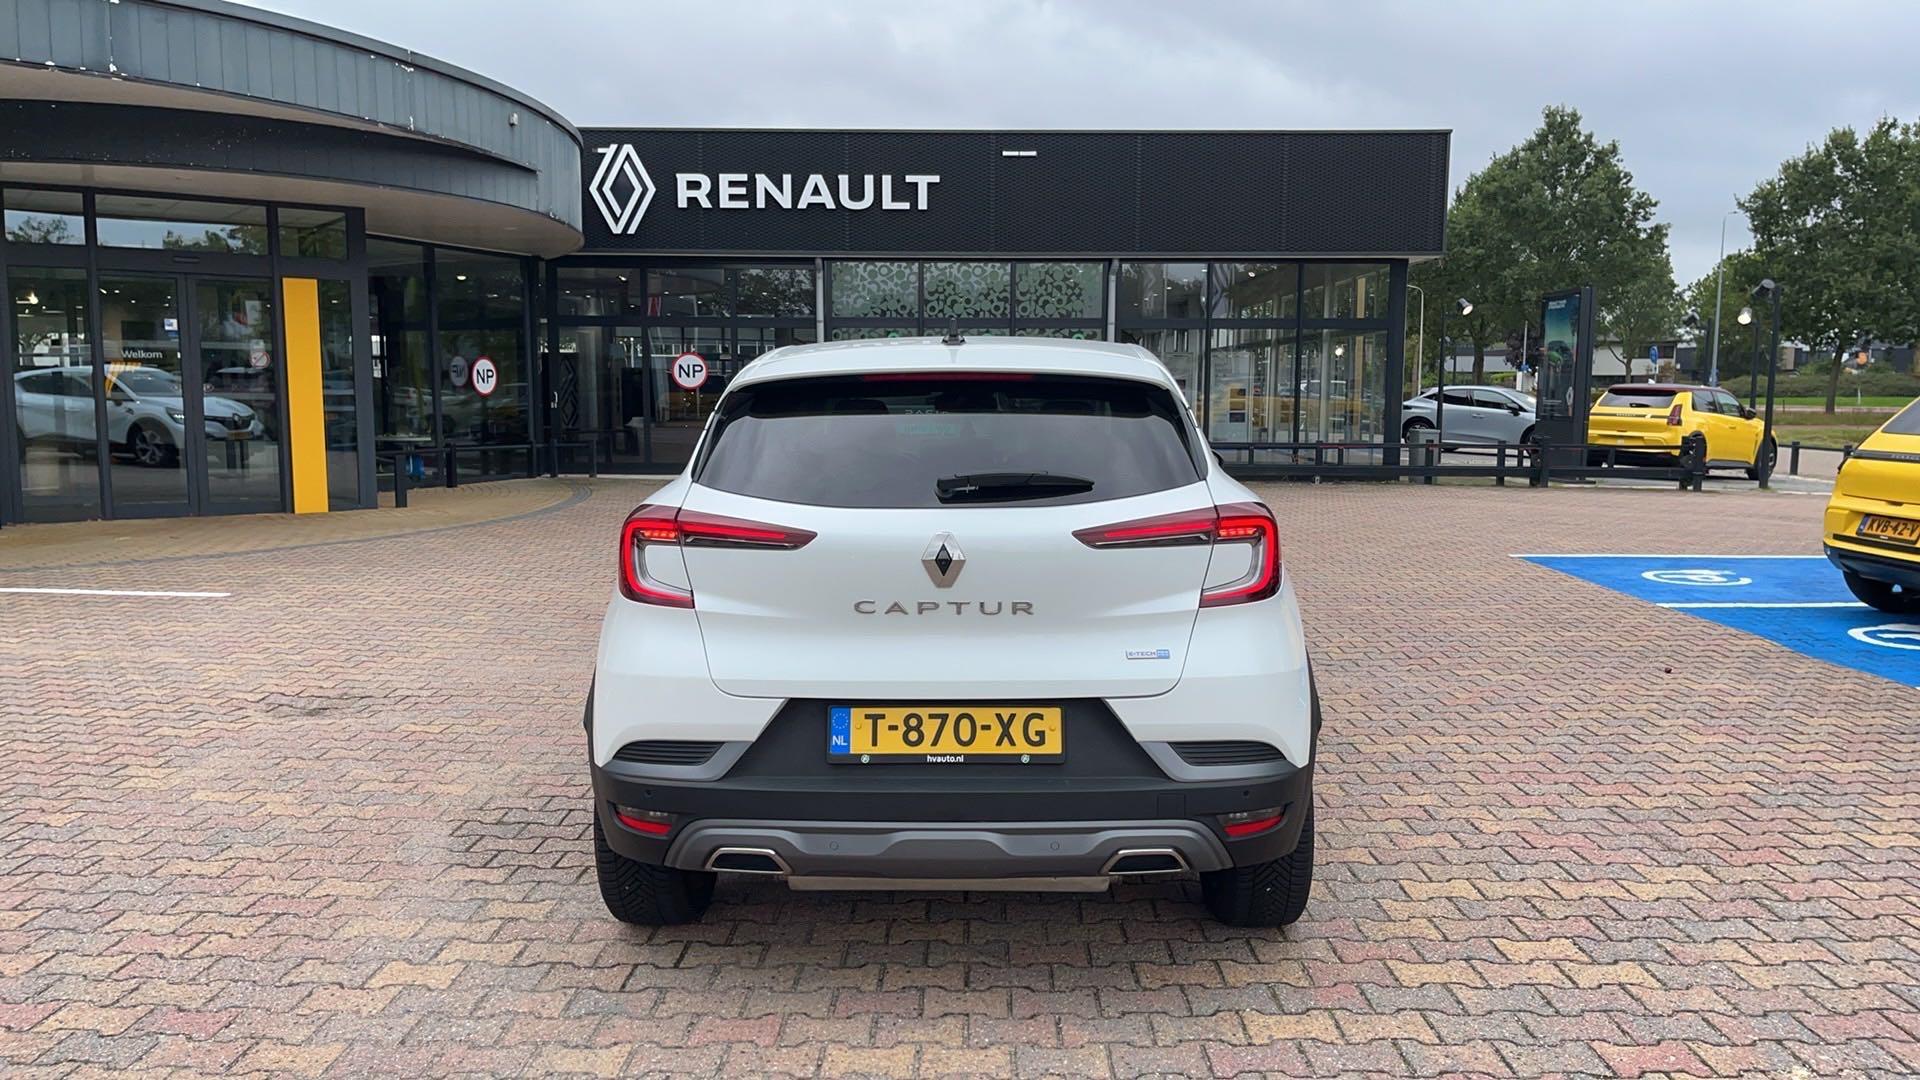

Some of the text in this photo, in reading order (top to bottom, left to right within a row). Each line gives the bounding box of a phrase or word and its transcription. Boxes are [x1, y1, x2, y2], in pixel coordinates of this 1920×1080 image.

[676, 173, 941, 211] RENAULT
[121, 349, 163, 359] Welkom
[476, 368, 495, 384] NP
[678, 363, 704, 379] NP
[853, 600, 1035, 616] CAPTUR
[864, 712, 1047, 748] T-870-XG
[832, 735, 848, 746] NL
[926, 754, 964, 764] hvauto.nl
